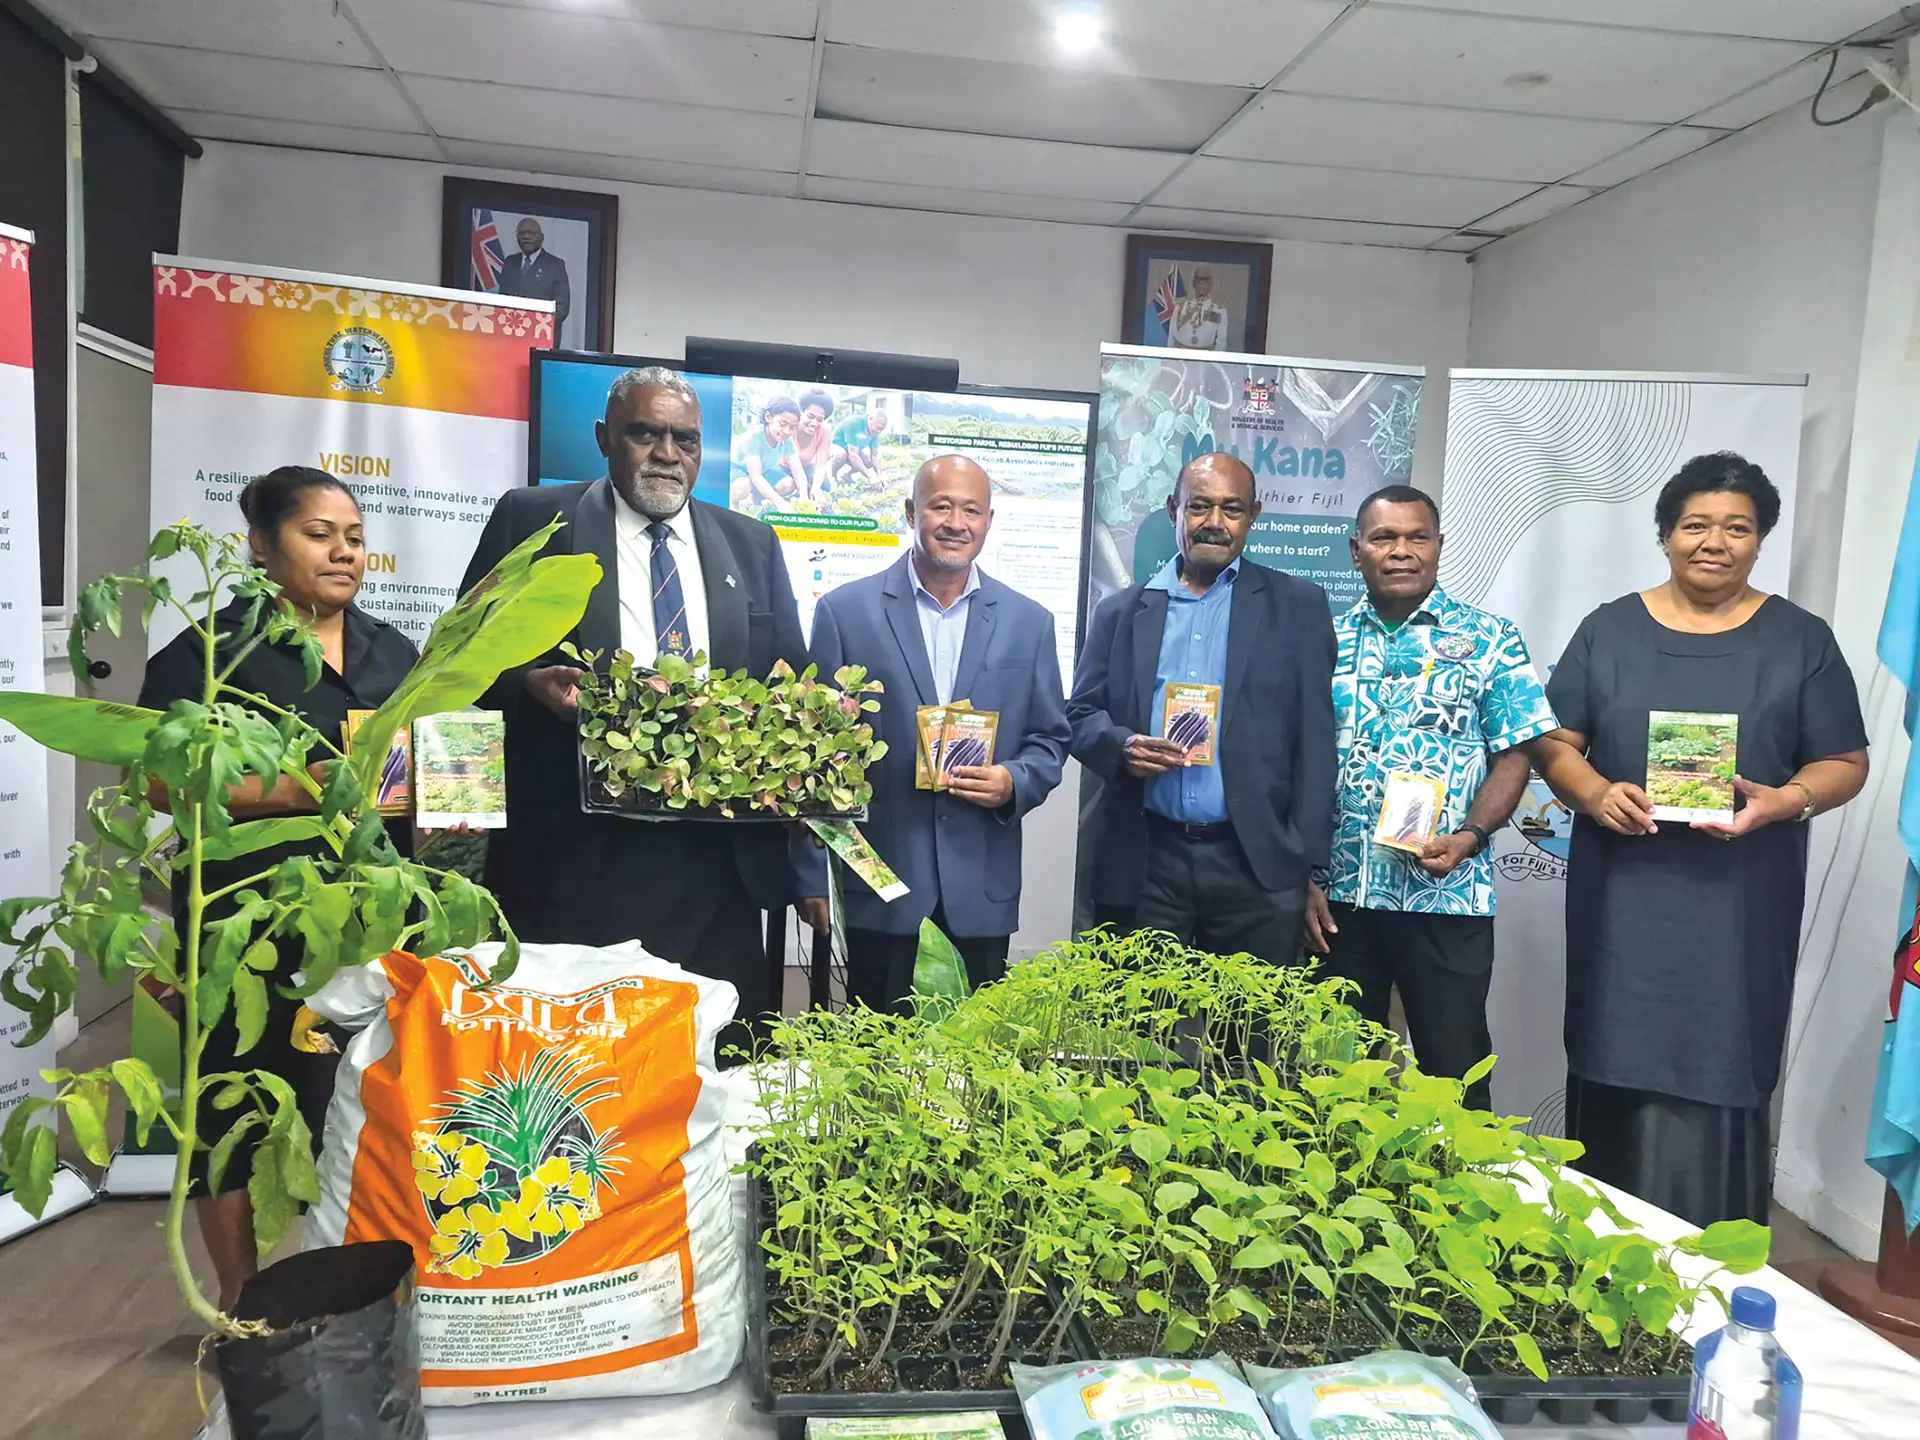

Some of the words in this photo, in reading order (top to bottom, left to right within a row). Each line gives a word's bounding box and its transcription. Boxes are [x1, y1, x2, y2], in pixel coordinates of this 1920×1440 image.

[934, 436, 972, 446] RESTORING
[998, 440, 1039, 450] REBUILDING
[1253, 436, 1346, 479] Kana
[319, 452, 390, 477] VISION
[196, 469, 204, 481] A
[350, 484, 410, 498] mpetitive,
[414, 486, 477, 504] innovative
[482, 496, 496, 506] an
[1260, 489, 1303, 504] lthier
[1312, 493, 1343, 508] Fiji!
[205, 488, 232, 502] food
[360, 502, 382, 513] and
[387, 504, 455, 522] waterways
[459, 512, 491, 523] secto
[798, 516, 829, 524] BACKYARD
[0, 525, 10, 534] eir
[1251, 522, 1268, 530] our
[1270, 520, 1300, 533] home
[1302, 524, 1349, 535] garden?
[0, 540, 10, 550] nd
[1250, 543, 1281, 554] where
[1284, 545, 1295, 555] to
[1297, 546, 1330, 557] start?
[1312, 570, 1328, 578] you
[1329, 570, 1352, 578] need
[1324, 582, 1333, 590] to
[1335, 582, 1357, 591] plant
[1, 601, 12, 610] we
[384, 617, 426, 631] limatic
[2, 675, 15, 684] our
[4, 734, 16, 743] our
[0, 792, 19, 802] liver
[3, 848, 21, 860] with
[1502, 856, 1524, 865] For
[1528, 858, 1556, 874] Fiji's
[10, 1020, 27, 1033] with
[440, 1010, 566, 1043] POTTING
[575, 1024, 626, 1038] MIX
[21, 1077, 30, 1087] to
[416, 1293, 486, 1305] ORTANT
[492, 1290, 558, 1305] HEALTH
[563, 1272, 639, 1297] WARNING
[448, 1312, 524, 1321] MICRO-ORGANISMS
[578, 1298, 614, 1310] HARMFUL
[628, 1288, 647, 1299] YOUR
[648, 1280, 676, 1292] HEALTH
[558, 1312, 582, 1321] MISTS
[514, 1333, 552, 1341] PRODUCT
[555, 1328, 579, 1336] MOIST
[590, 1319, 616, 1331] DUSTY
[559, 1319, 585, 1329] DUSTY
[498, 1341, 537, 1349] PRODUCT
[539, 1338, 564, 1346] MOIST
[566, 1332, 590, 1342] WHEN
[592, 1323, 631, 1337] HANDLING
[491, 1348, 543, 1356] IMMEDIATELY
[544, 1344, 570, 1352] AFTER
[508, 1350, 563, 1363] INSTRUCTION
[597, 1341, 614, 1349] BAG
[496, 1387, 547, 1397] LITRES
[1121, 1416, 1169, 1437] LONG
[1172, 1412, 1219, 1425] BEAN
[1356, 1418, 1404, 1431] LONG
